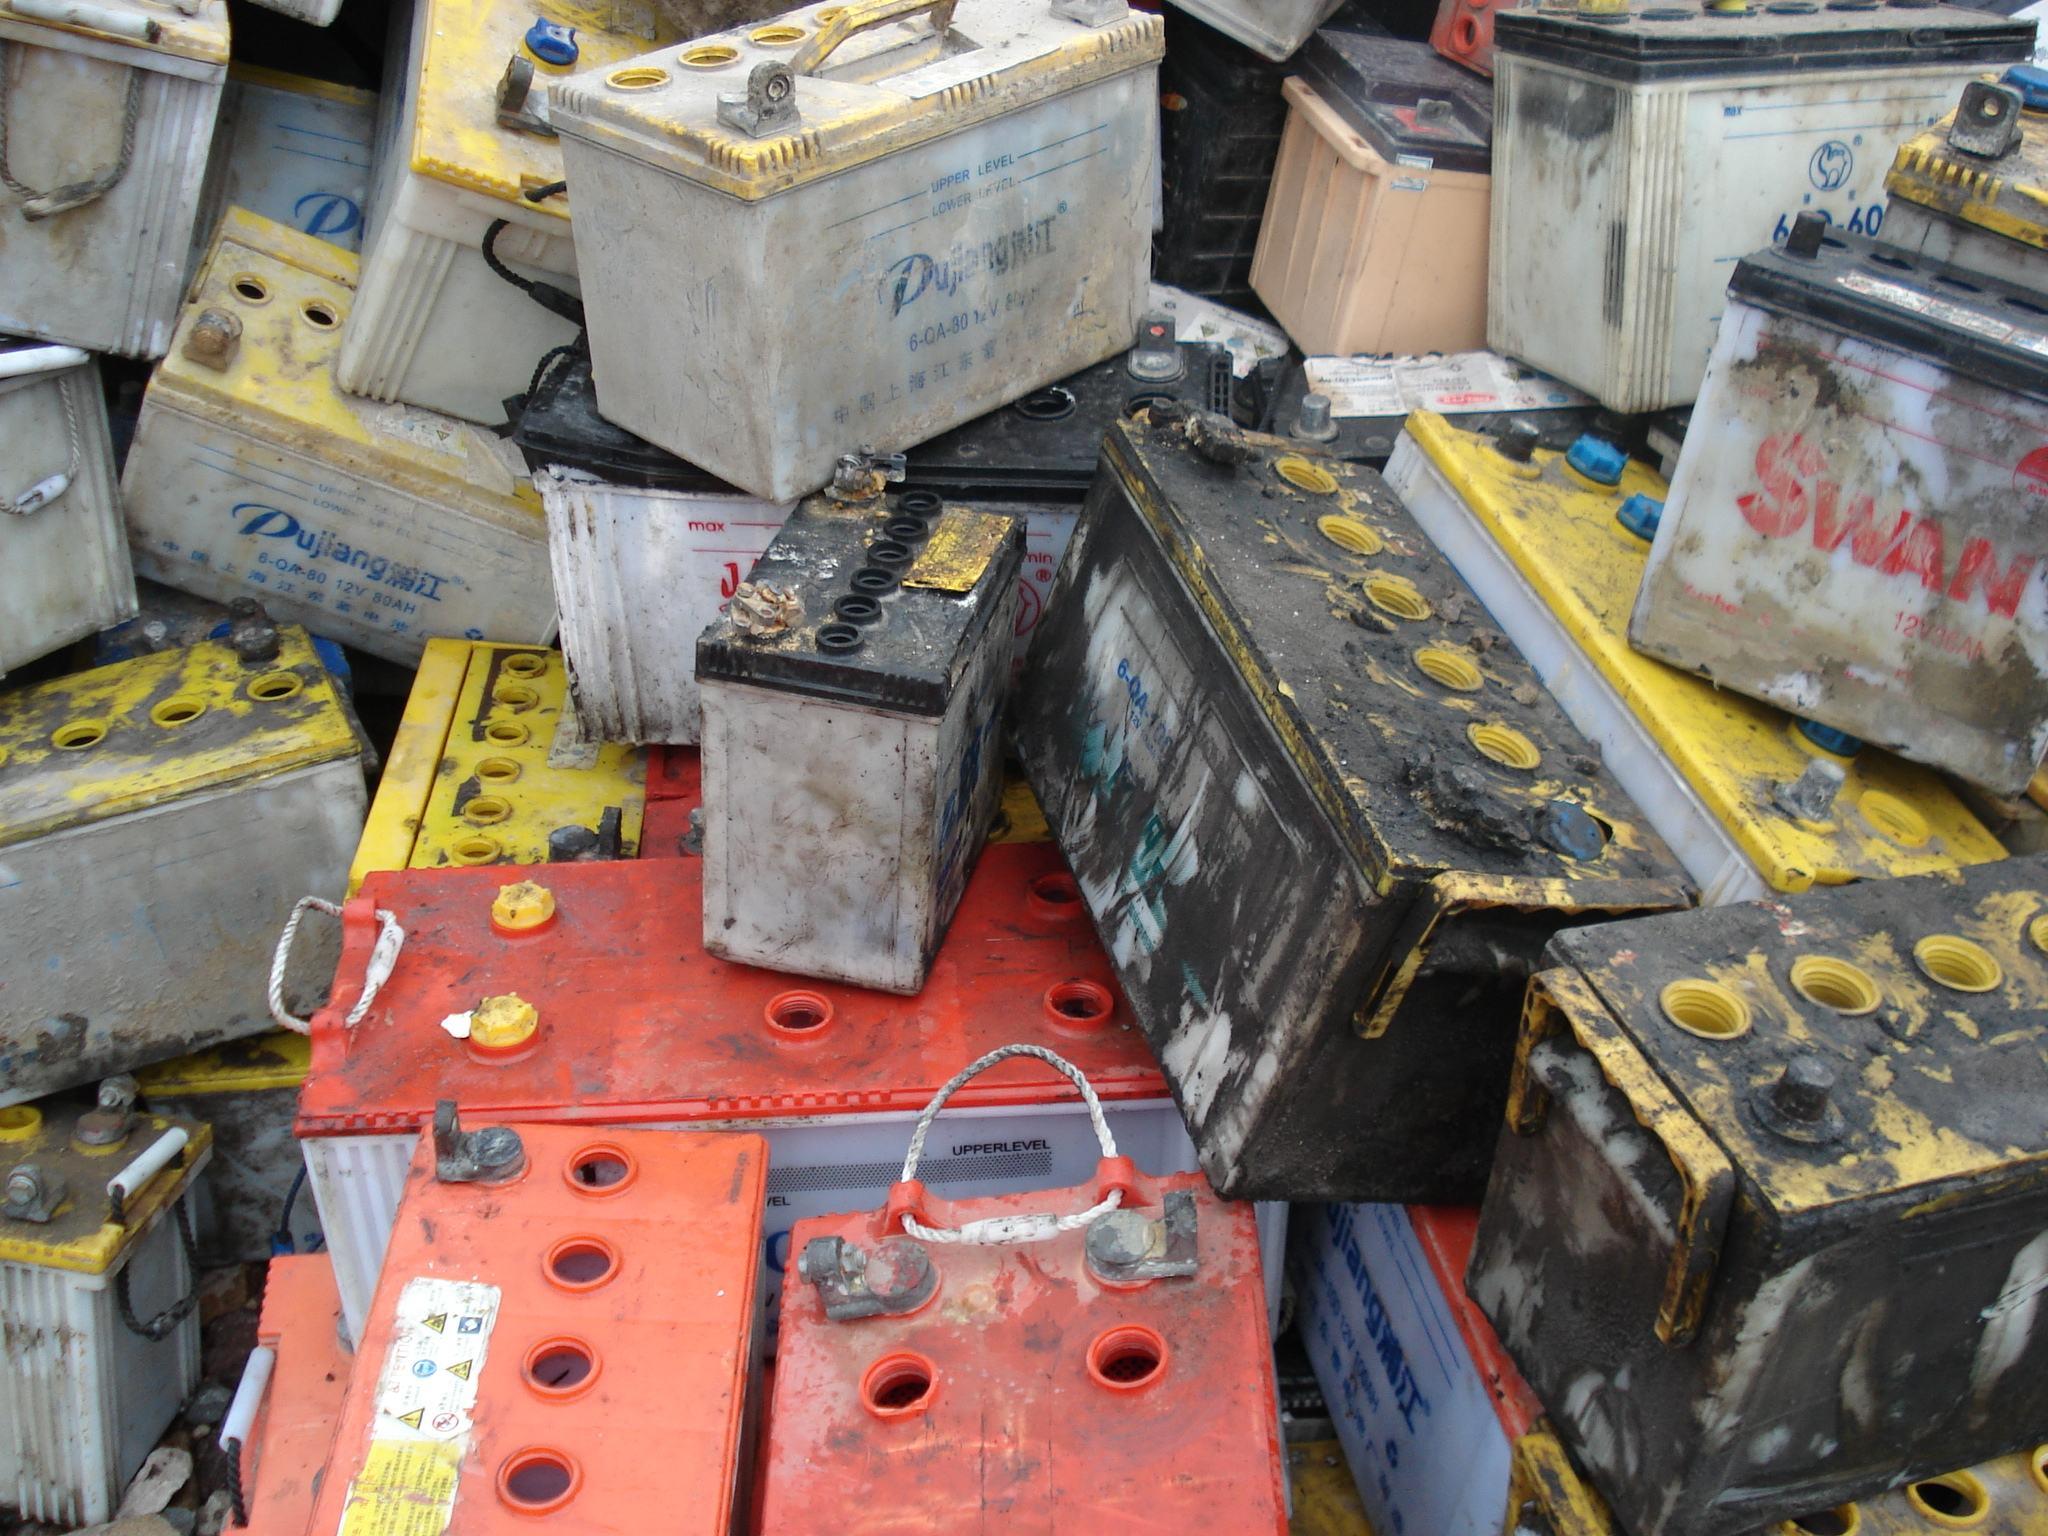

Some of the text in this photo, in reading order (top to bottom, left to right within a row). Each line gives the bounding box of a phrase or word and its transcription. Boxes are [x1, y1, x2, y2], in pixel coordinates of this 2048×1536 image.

[1723, 106, 1743, 117] max
[931, 153, 1015, 193] UPPER LEVEL
[932, 192, 972, 217] LOWER
[688, 519, 726, 533] max
[1736, 433, 2037, 619] SWAN
[1026, 552, 1053, 564] min
[258, 552, 416, 614] 6-QA-80 12V 80AH
[952, 1139, 1051, 1156] UPPERLEVEL
